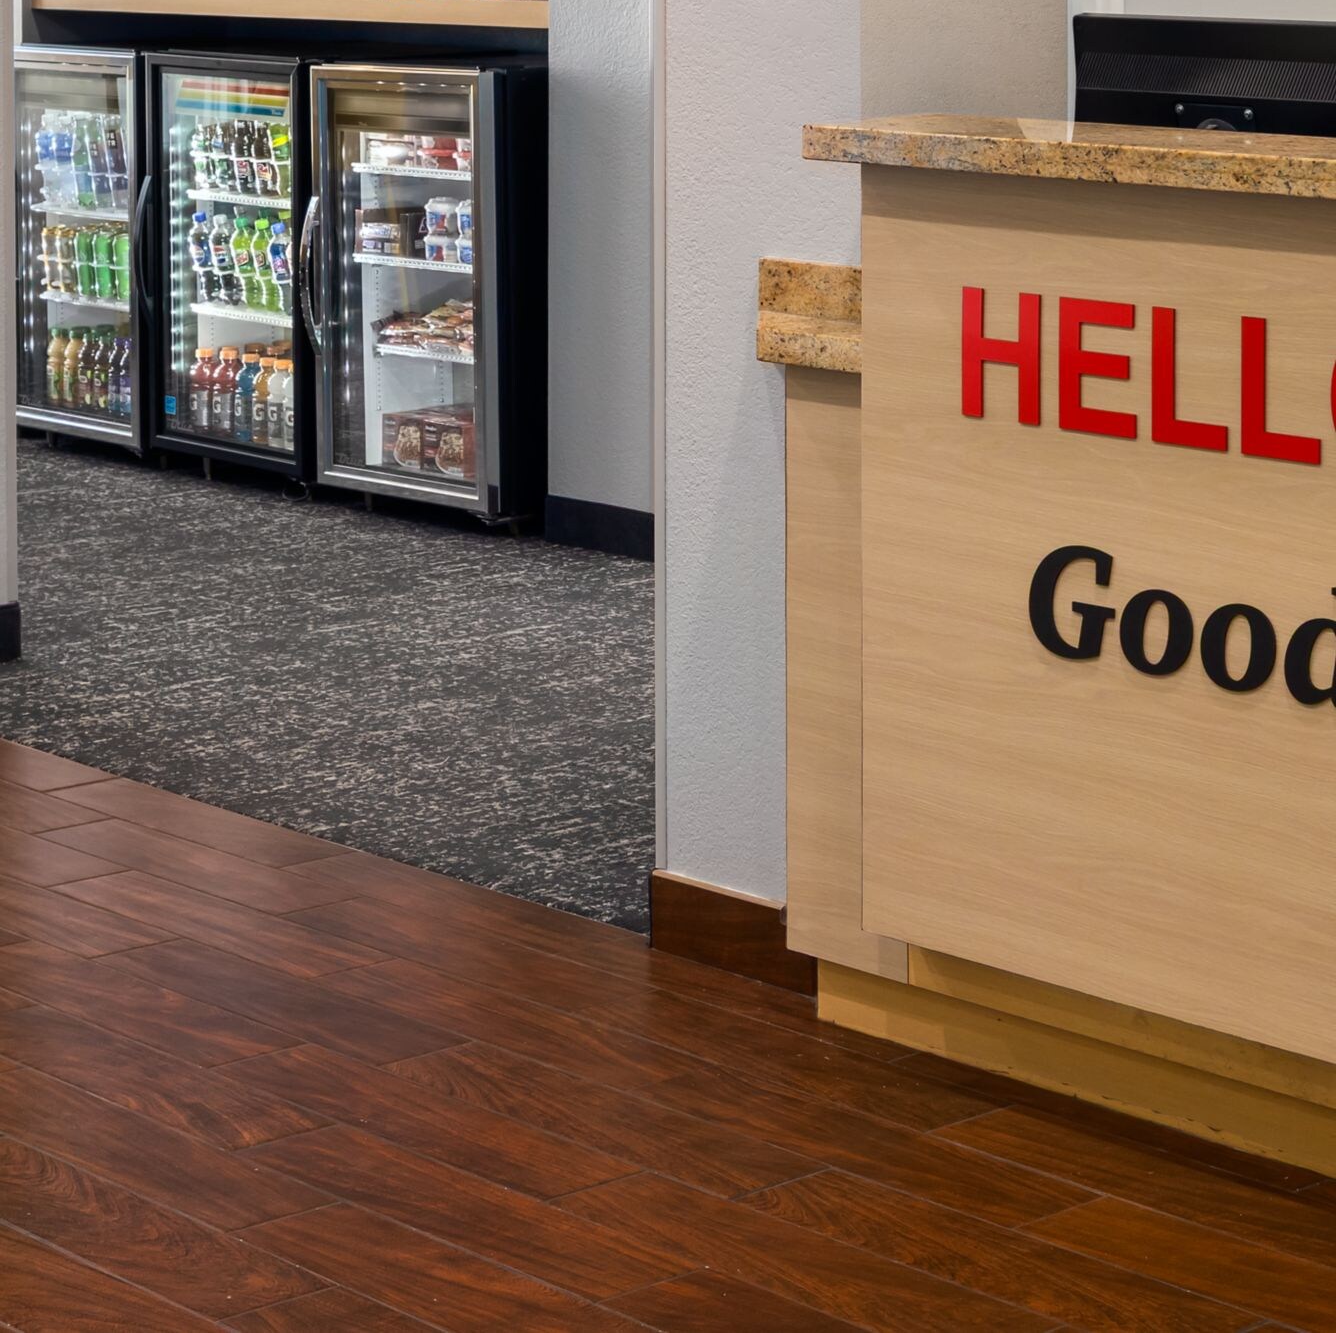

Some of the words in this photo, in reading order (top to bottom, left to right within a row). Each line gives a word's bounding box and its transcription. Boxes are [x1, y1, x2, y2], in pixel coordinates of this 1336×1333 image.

[961, 285, 1336, 467] HELL
[212, 395, 222, 414] G
[253, 403, 265, 421] G
[268, 406, 278, 422] G
